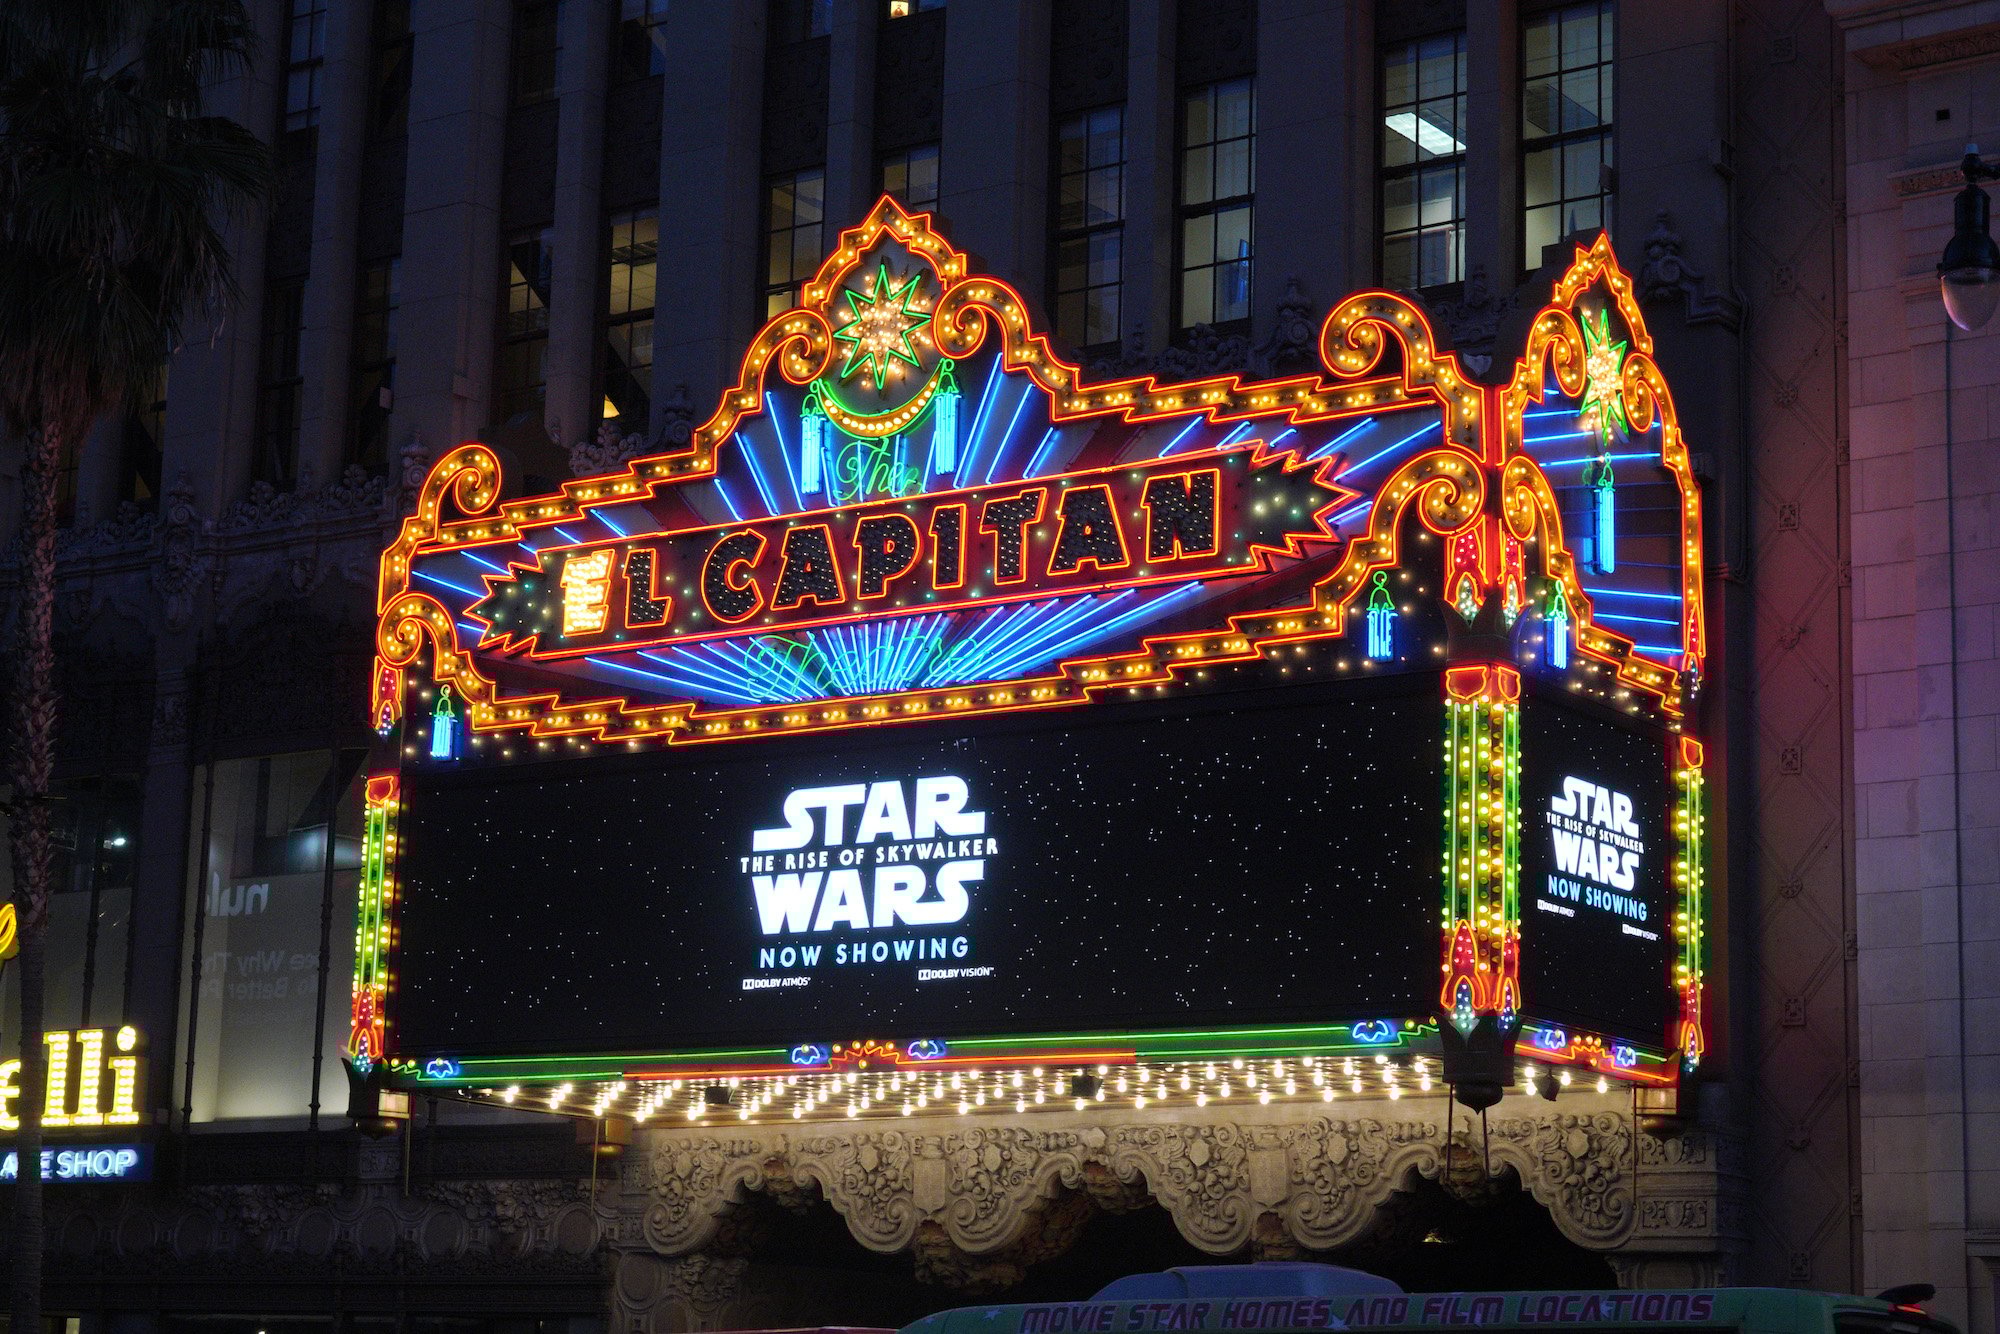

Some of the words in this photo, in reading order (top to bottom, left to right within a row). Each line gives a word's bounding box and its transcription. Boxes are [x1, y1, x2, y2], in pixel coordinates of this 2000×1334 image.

[833, 437, 919, 501] The
[560, 548, 672, 637] EL
[700, 468, 1220, 624] CAPITAN
[752, 775, 986, 852] STAR
[1551, 775, 1640, 839] STAR
[740, 856, 775, 874] THE
[785, 851, 829, 871] RISE
[839, 848, 865, 866] OF
[875, 837, 998, 864] SKYWALKER
[1546, 812, 1562, 828] THE
[1564, 817, 1583, 833] RISE
[1585, 824, 1597, 838] OF
[1599, 828, 1645, 854] SKYWALKER
[1551, 827, 1640, 892] WARS
[751, 859, 986, 935] WARS
[1548, 874, 1581, 902] NOW
[1585, 886, 1648, 922] SHOWING
[759, 945, 822, 969] NOW
[835, 936, 969, 965] SHOWING
[931, 969, 959, 980] DOLBY
[754, 978, 781, 989] DOLBY
[56, 1149, 138, 1179] SHOP
[1019, 1305, 1119, 1334] MOVIE
[1126, 1302, 1212, 1331] STAR
[1221, 1299, 1334, 1329] HOMES
[1343, 1297, 1410, 1327] AND
[1420, 1296, 1506, 1326] FILM
[1516, 1293, 1716, 1323] LOCATIONS
